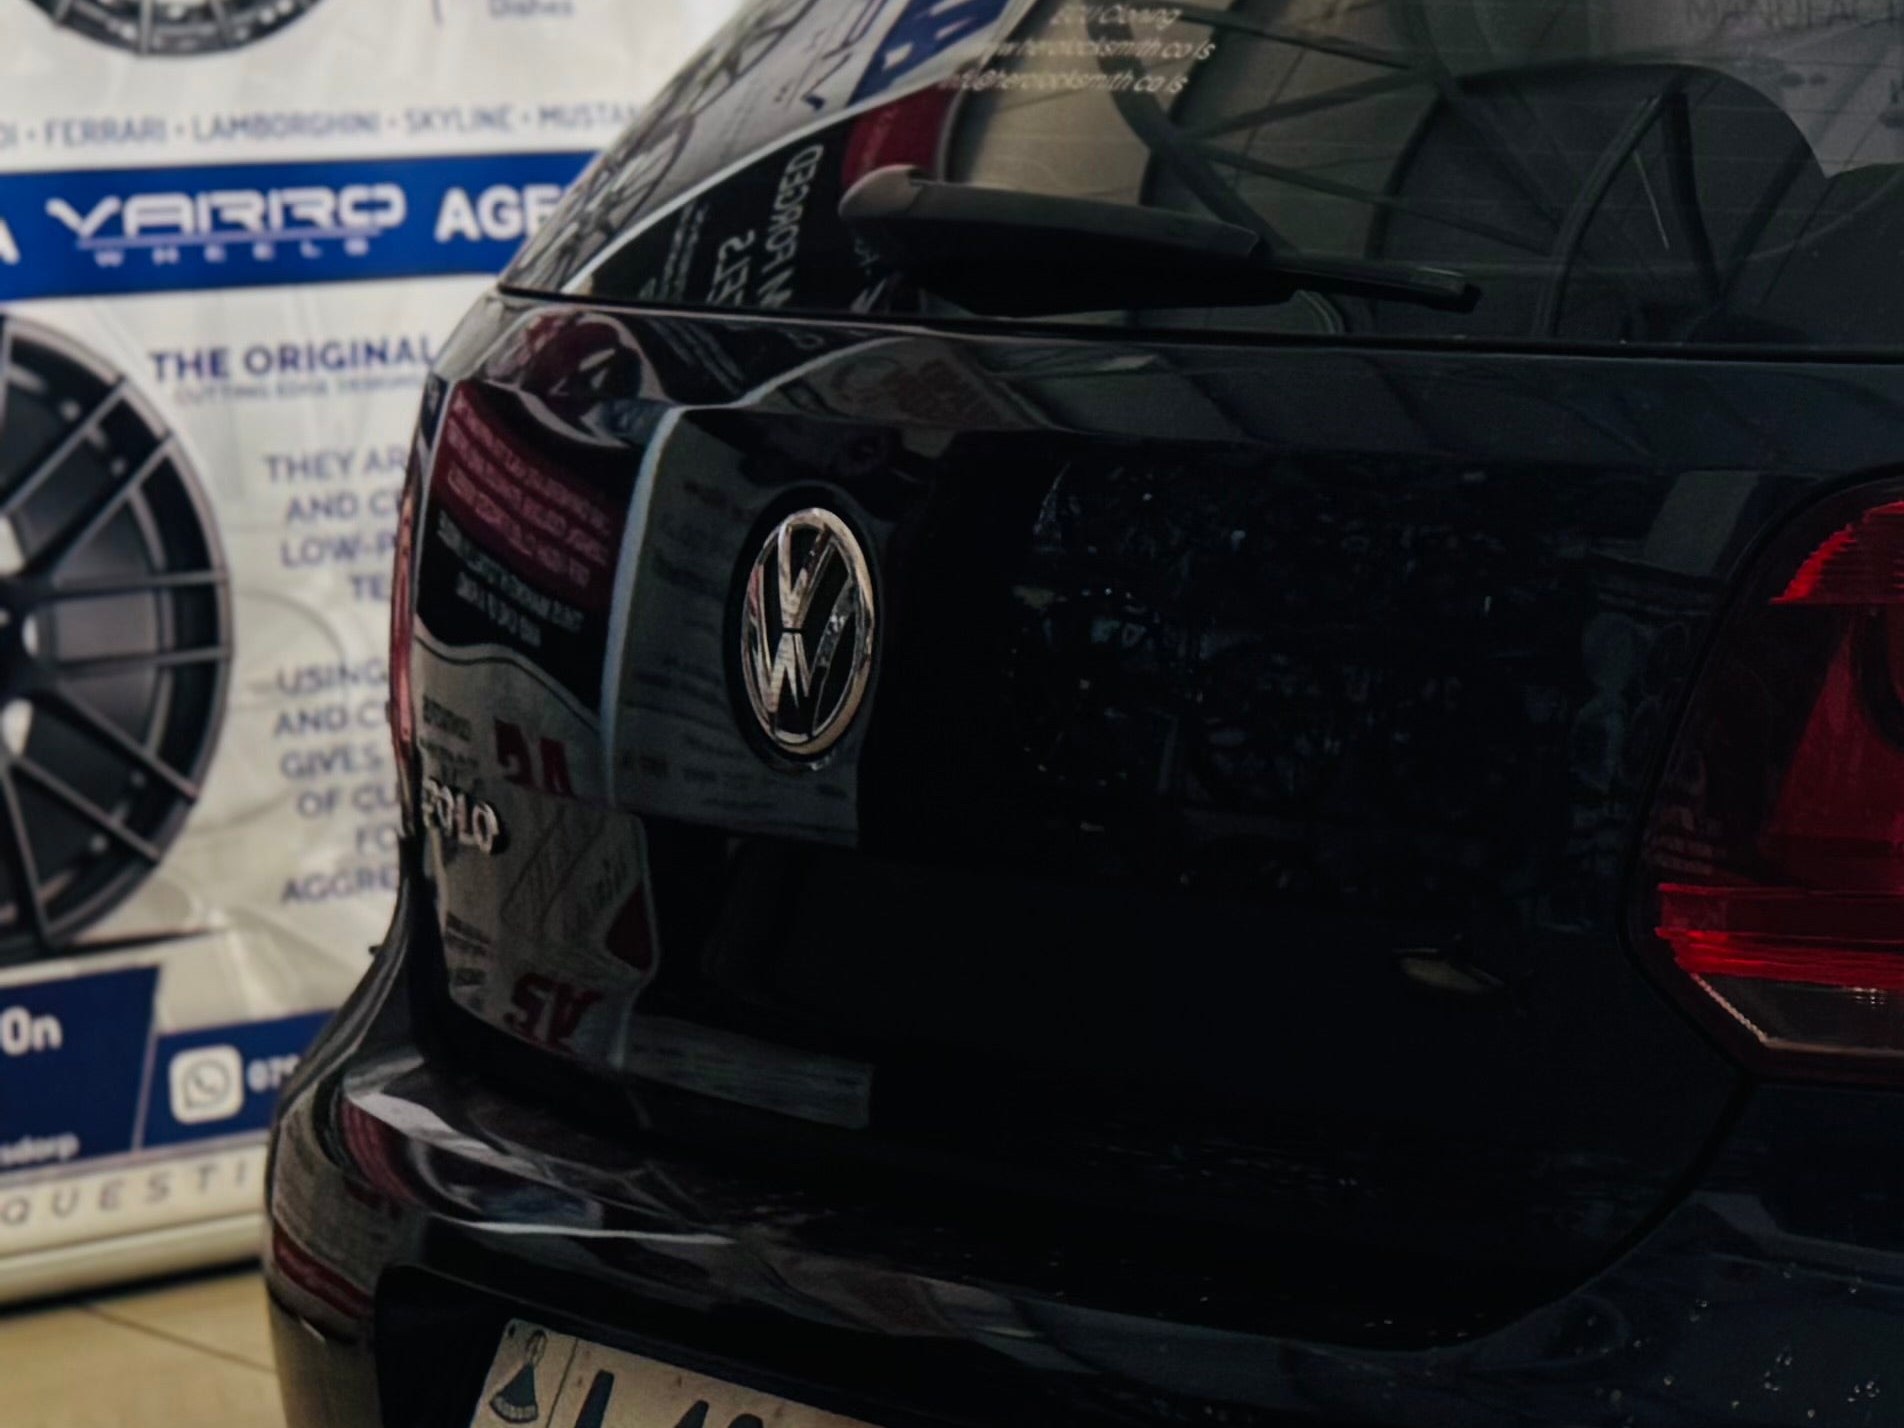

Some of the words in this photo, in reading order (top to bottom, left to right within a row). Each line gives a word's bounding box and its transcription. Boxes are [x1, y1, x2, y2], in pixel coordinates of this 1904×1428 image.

[434, 183, 568, 243] AGE
[149, 348, 229, 380] THE
[243, 334, 438, 376] ORIGINAL
[265, 450, 354, 483] THEY
[287, 491, 359, 522] AND
[277, 658, 387, 696] USING
[273, 703, 346, 737] AND
[281, 743, 383, 780] GIVES
[298, 786, 342, 817] OF
[0, 1158, 248, 1223] QUESTI
